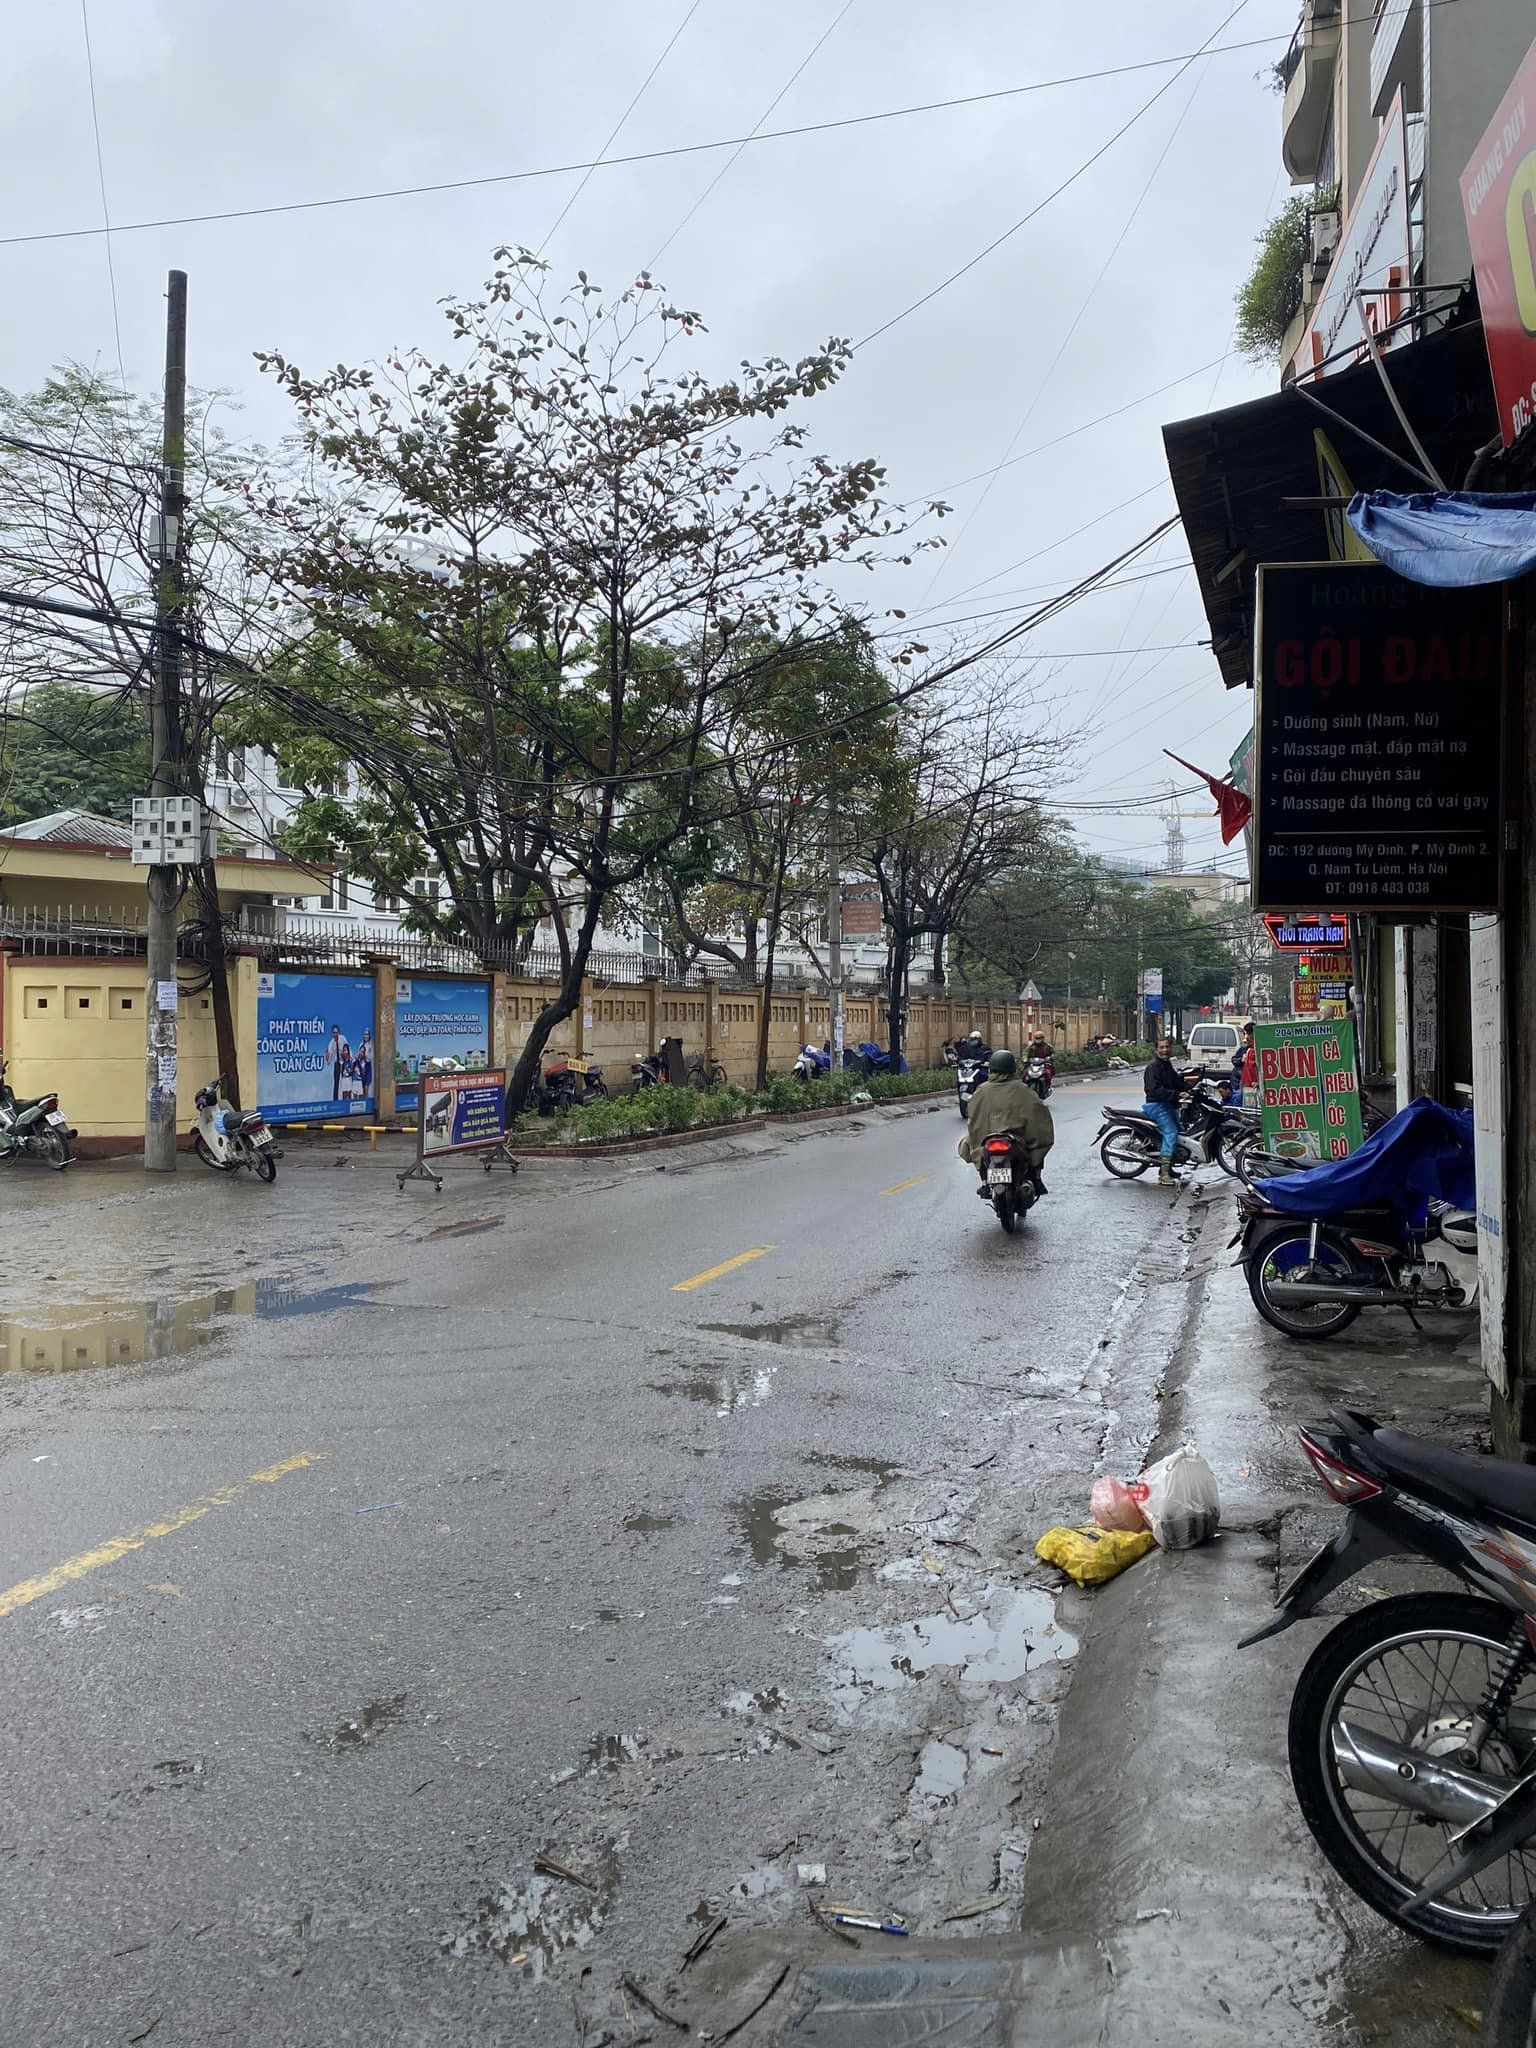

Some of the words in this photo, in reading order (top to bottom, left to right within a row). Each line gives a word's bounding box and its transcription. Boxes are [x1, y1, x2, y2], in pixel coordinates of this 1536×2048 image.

[1503, 96, 1526, 156] DUY
[1274, 624, 1361, 699] GỘI
[1332, 714, 1361, 729] sinh
[1283, 742, 1346, 759] Massage
[1340, 766, 1391, 785] chuyên
[1395, 766, 1421, 781] sâu
[1282, 796, 1345, 813] Massage
[1350, 795, 1367, 809] đá
[1372, 795, 1411, 811] thông
[1437, 795, 1458, 808] vai
[1268, 845, 1289, 857] ĐC:
[1293, 845, 1314, 856] 192
[1411, 843, 1423, 855] P.
[1308, 864, 1321, 877] Q.
[1324, 863, 1351, 875] Nam
[1325, 882, 1345, 894] ĐT:
[1348, 882, 1378, 894] 0918
[1381, 882, 1404, 894] 483
[1407, 881, 1430, 894] 038
[1297, 927, 1324, 942] TRANG
[1326, 927, 1344, 942] NAM
[269, 1018, 296, 1035] PHÁT
[298, 1016, 325, 1034] TRIỂN
[257, 1037, 285, 1054] CÔNG
[286, 1036, 308, 1053] DÂN
[274, 1056, 302, 1073] TOÀN
[1261, 1040, 1317, 1080] BÚN
[1324, 1068, 1354, 1093] RIÊU
[1265, 1083, 1319, 1107] BÁNH
[1280, 1110, 1308, 1130] ĐA
